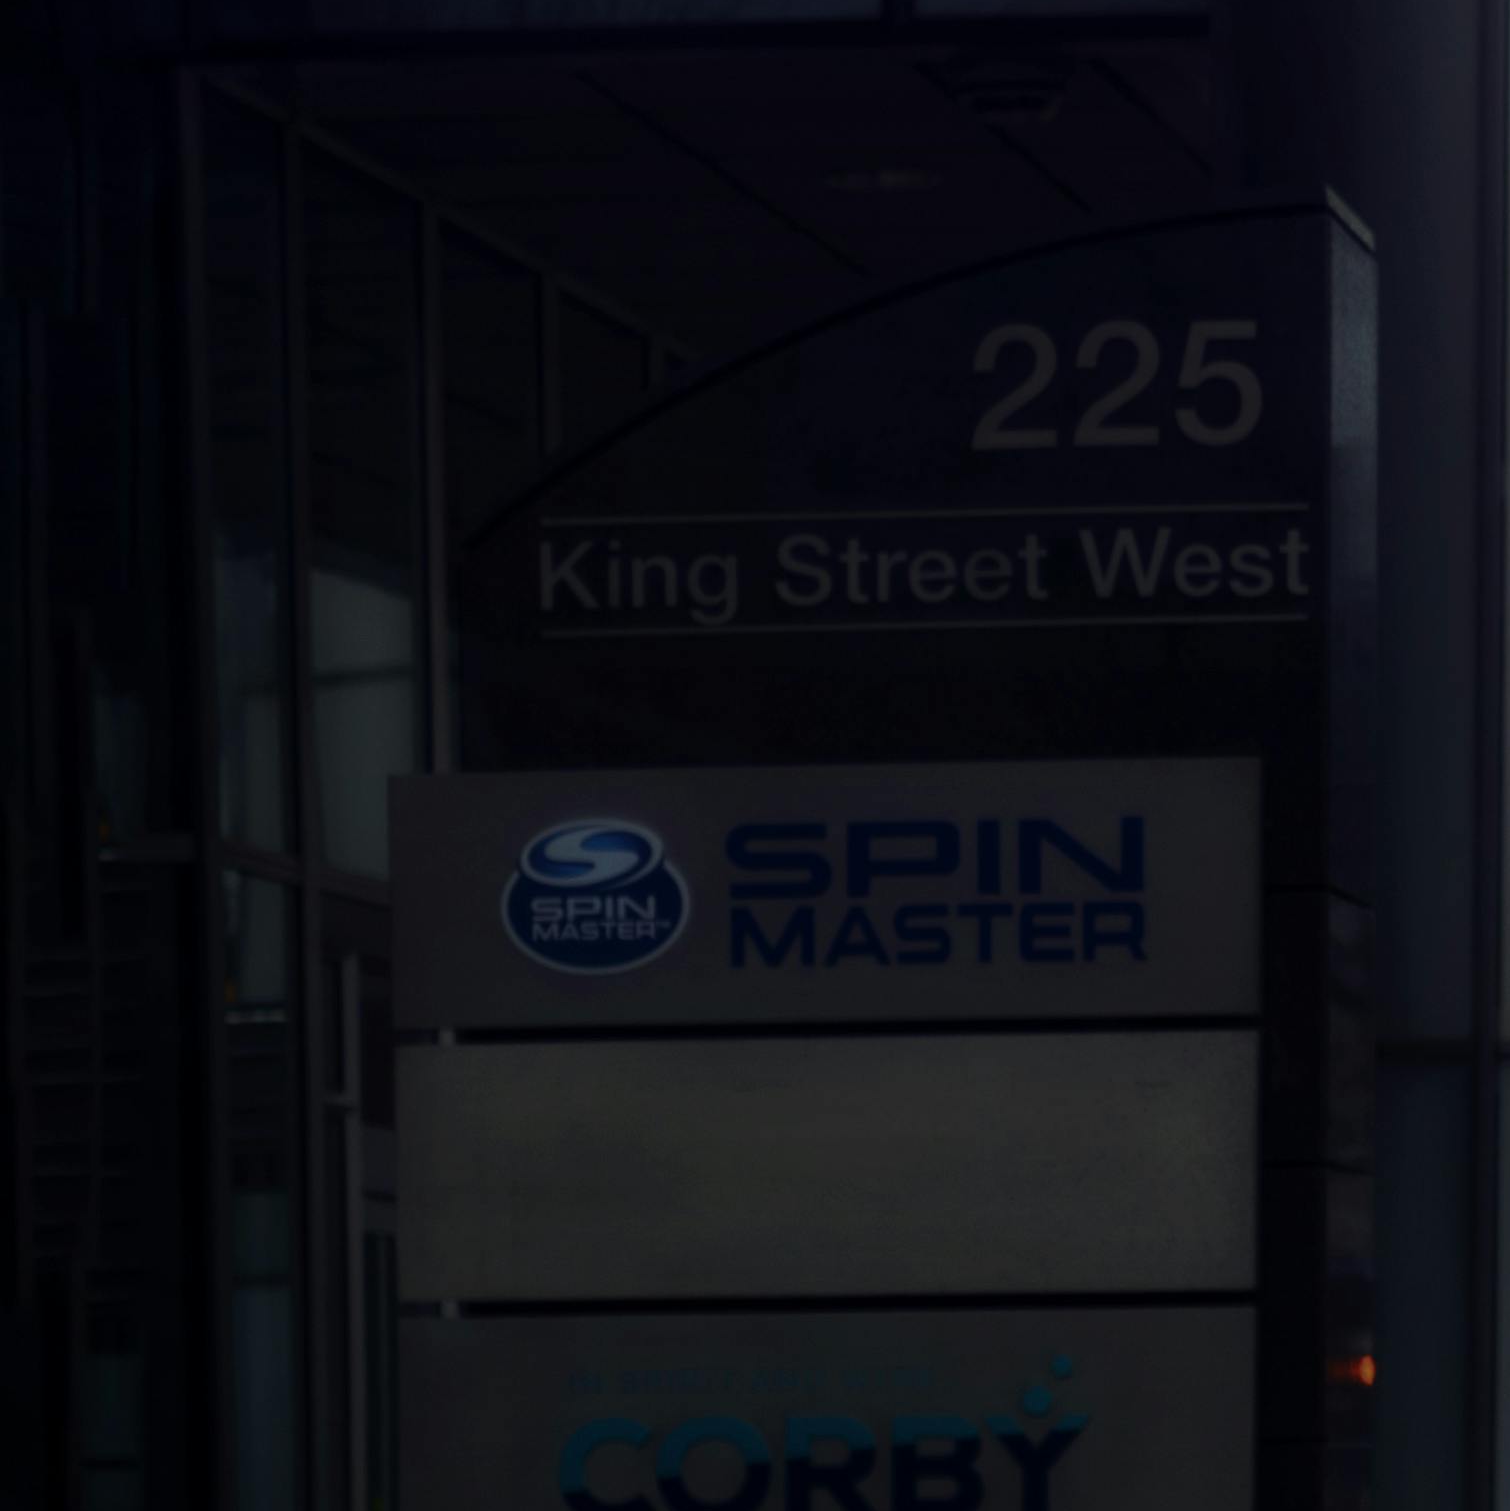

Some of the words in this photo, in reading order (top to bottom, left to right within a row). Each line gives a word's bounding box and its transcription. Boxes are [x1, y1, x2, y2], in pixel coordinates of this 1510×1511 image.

[970, 318, 1264, 451] 225
[536, 539, 741, 625] King
[773, 531, 1049, 607] Street
[1078, 524, 1311, 597] West
[725, 816, 1144, 900] SPIN
[530, 894, 657, 923] SPIN
[729, 901, 1148, 970] MASTER
